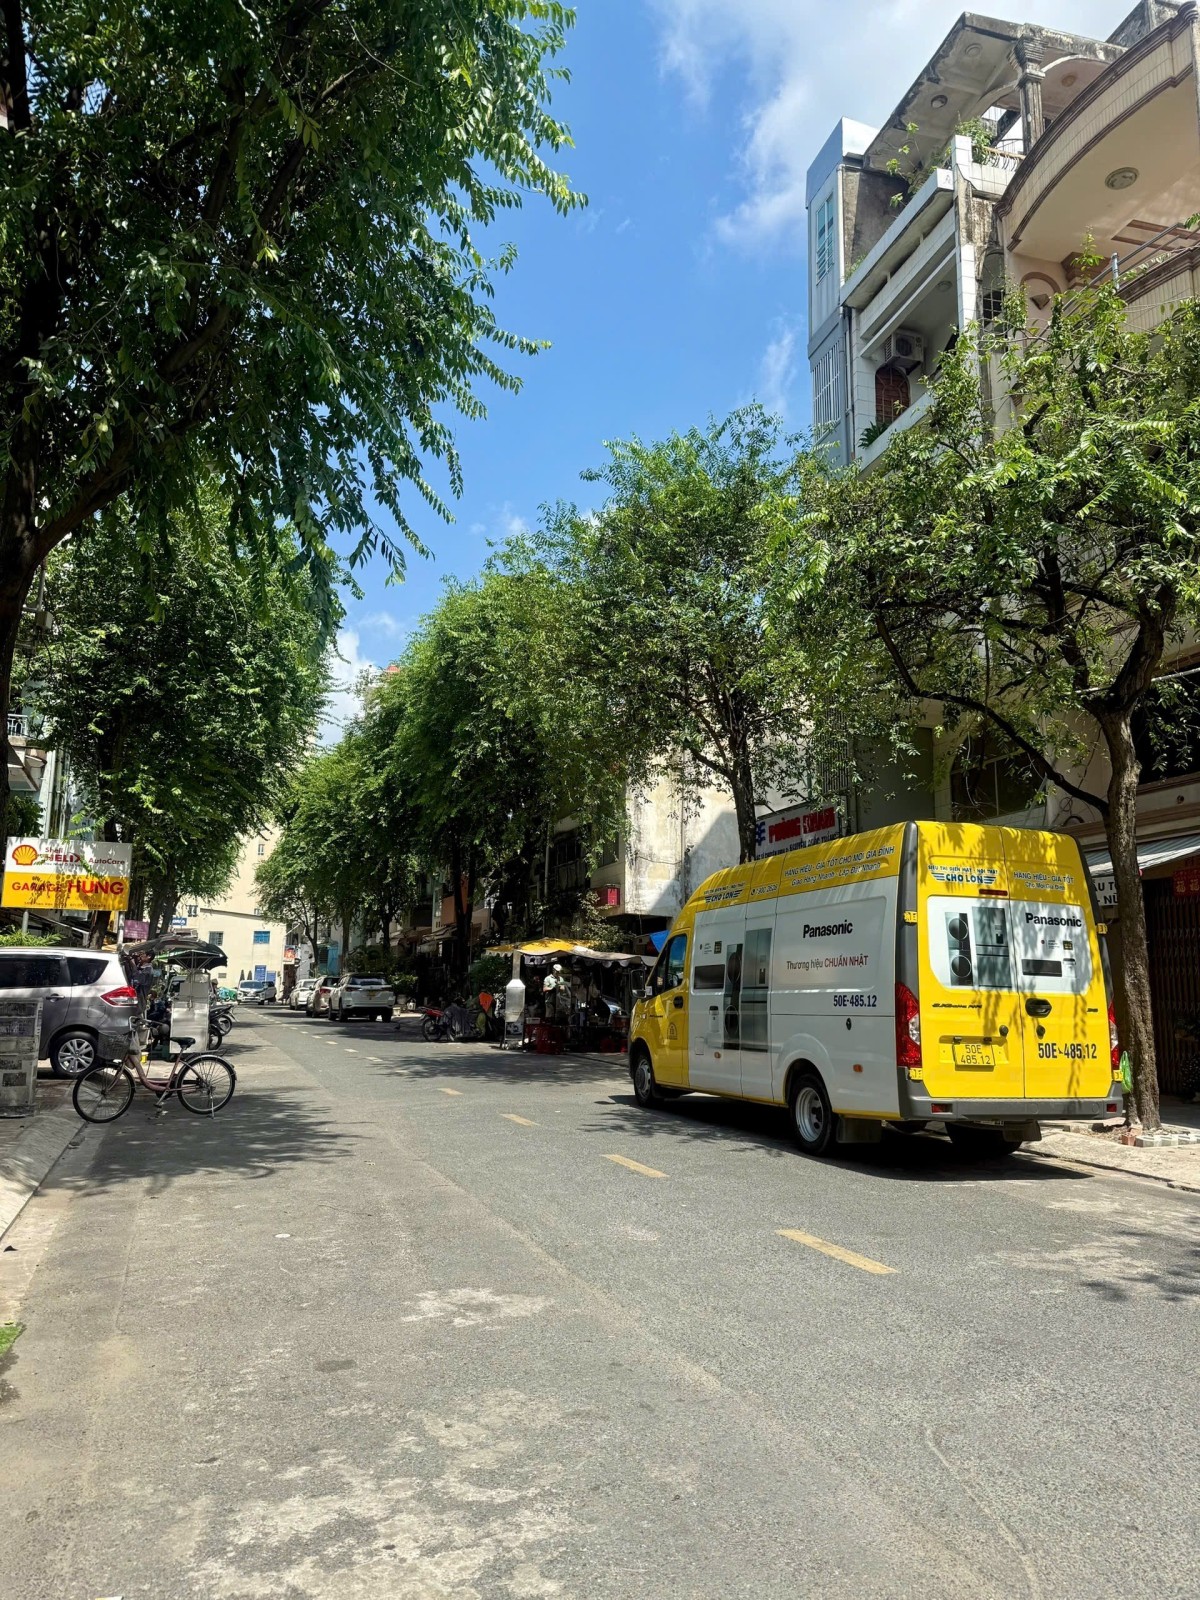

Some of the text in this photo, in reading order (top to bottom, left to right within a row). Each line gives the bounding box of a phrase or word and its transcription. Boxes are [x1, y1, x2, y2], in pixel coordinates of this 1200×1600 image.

[1025, 912, 1082, 927] Panasonic
[803, 919, 853, 938] Panasonic
[786, 961, 809, 971] Thương
[810, 958, 823, 970] hiệu
[833, 994, 877, 1007] 50E-485.12
[965, 1044, 982, 1054] 50E
[1038, 1042, 1098, 1059] 50E-485.12
[960, 1054, 991, 1065] 485.12
